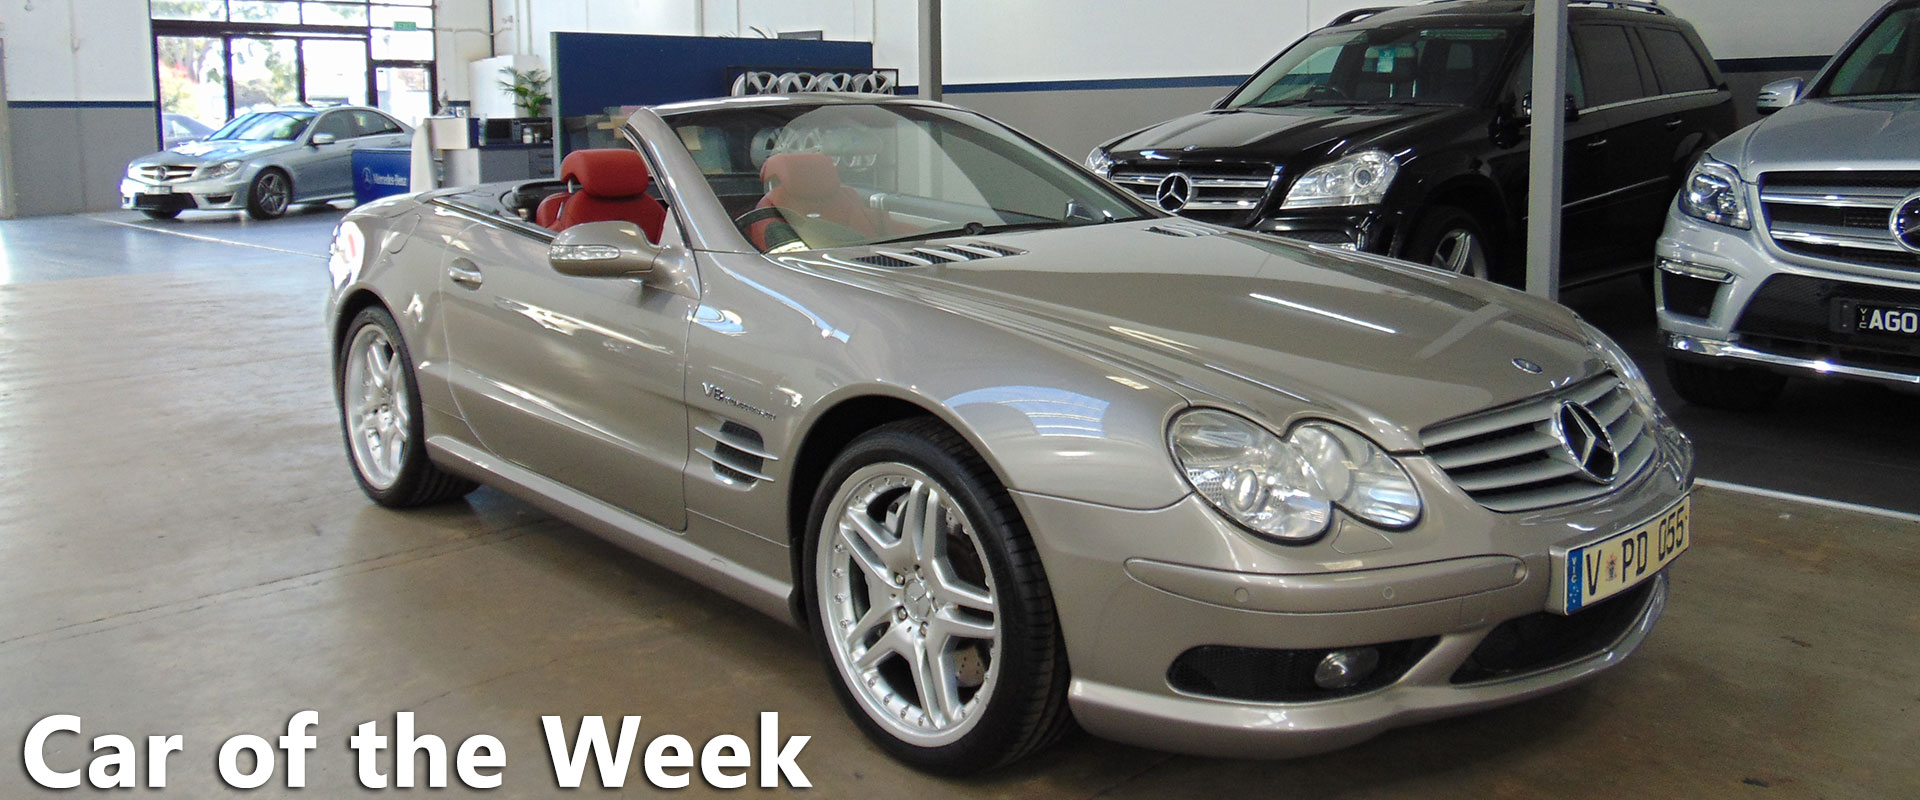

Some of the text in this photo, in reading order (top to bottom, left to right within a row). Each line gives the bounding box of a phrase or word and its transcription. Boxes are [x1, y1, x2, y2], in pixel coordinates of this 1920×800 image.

[1859, 308, 1868, 329] VIC
[702, 382, 724, 401] V8
[1586, 550, 1602, 596] V
[1622, 531, 1648, 583] PD
